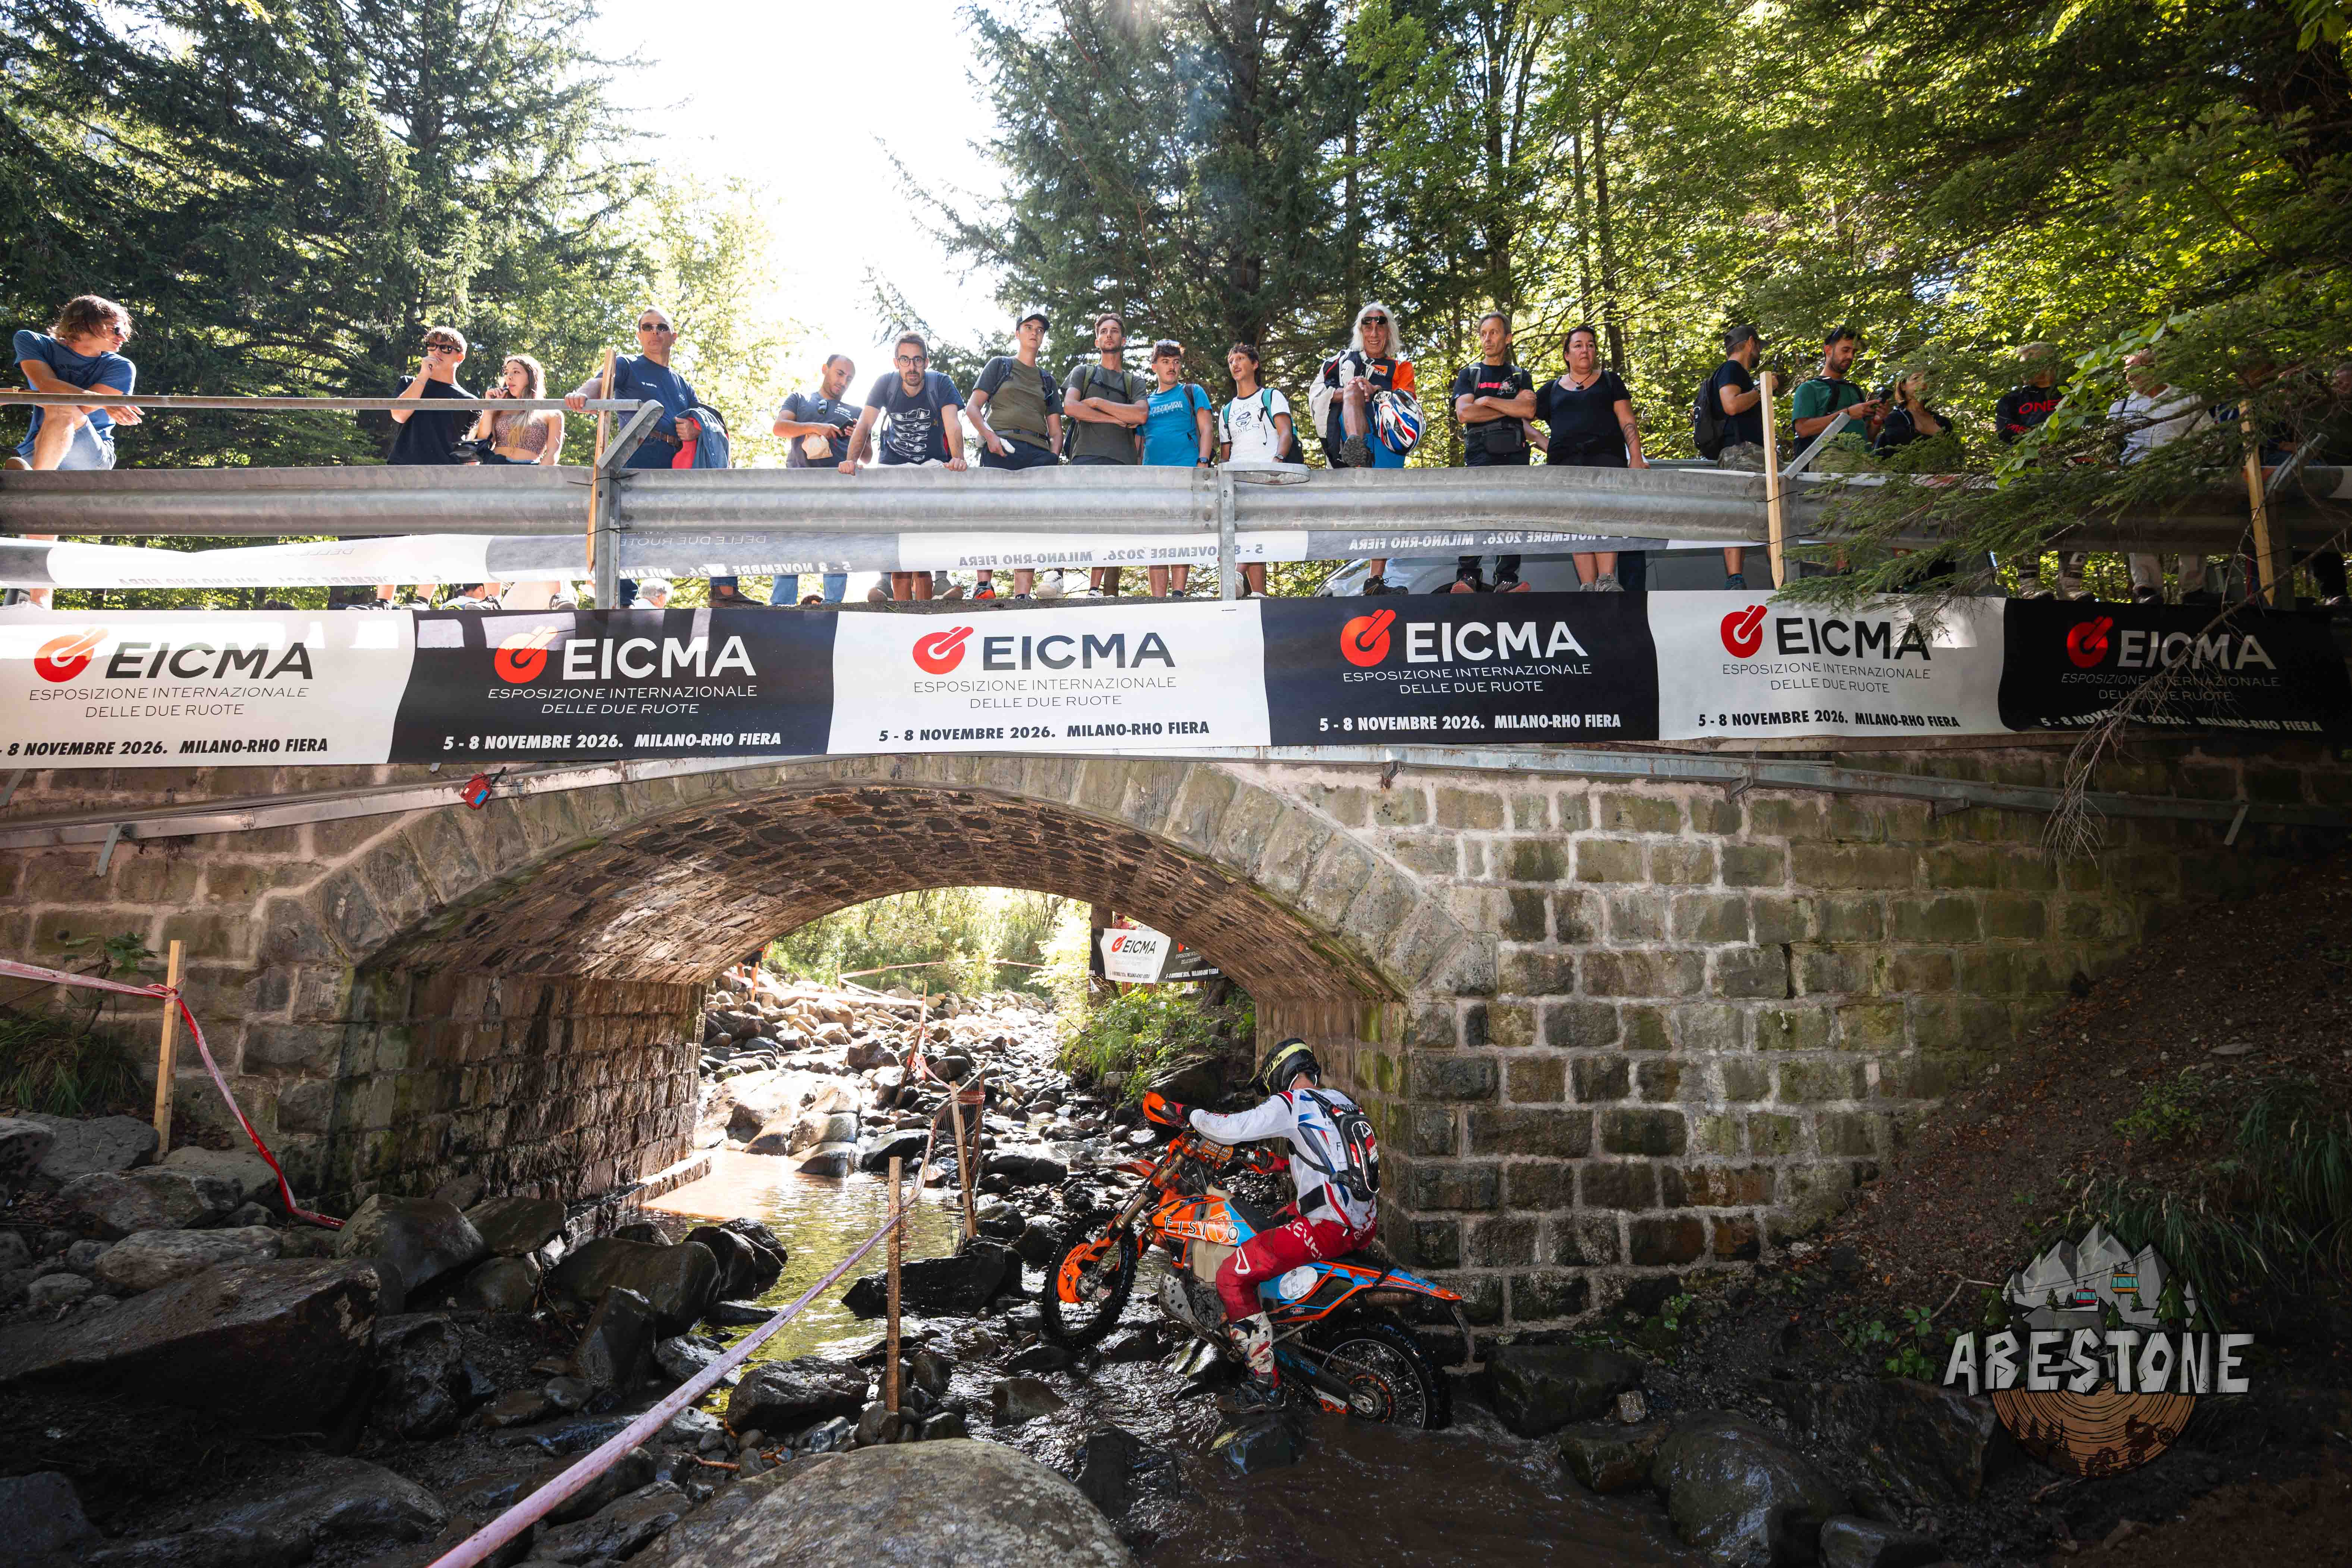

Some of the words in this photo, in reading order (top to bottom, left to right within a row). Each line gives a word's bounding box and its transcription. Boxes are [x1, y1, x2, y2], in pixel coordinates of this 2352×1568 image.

[1406, 621, 1588, 663] EICMA
[1776, 617, 1932, 660] EICMA
[563, 635, 757, 680] EICMA
[983, 632, 1176, 671] EICMA
[2117, 630, 2277, 670] EICMA
[105, 642, 313, 680] EICMA
[1343, 669, 1453, 682] ESPOSIZIONE
[1456, 664, 1592, 678] INTERNAZIONALE
[1723, 662, 1821, 675] ESPOSIZIONE
[1823, 663, 1931, 679] INTERNAZIONALE
[488, 688, 606, 699] ESPOSIZIONE
[610, 685, 757, 698] INTERNAZIONALE
[914, 680, 1029, 693] ESPOSIZIONE
[1033, 677, 1177, 690] INTERNAZIONALE
[1400, 683, 1451, 694] DELLE
[1454, 682, 1487, 692] DUE
[1491, 681, 1544, 692] RUOTE
[1771, 678, 1820, 690] DELLE
[1822, 678, 1847, 690] DUE
[1849, 681, 1890, 693] RUOTE
[29, 688, 150, 701] ESPOSIZIONE
[153, 687, 309, 698] INTERNAZIONALE
[970, 698, 1023, 708] DELLE
[1027, 697, 1062, 707] DUE
[1066, 695, 1122, 706] RUOTE
[85, 706, 141, 717] DELLE
[145, 705, 181, 716] DUE
[185, 704, 244, 716] RUOTE
[541, 704, 597, 714] DELLE
[601, 704, 637, 714] DUE
[641, 704, 700, 714] RUOTE
[1320, 718, 1329, 731] 5
[1343, 717, 1353, 731] 8
[1358, 716, 1437, 730] NOVEMBRE
[1442, 715, 1485, 729] 2026.
[1494, 714, 1580, 728] MILANO-RHO
[1585, 714, 1621, 728] FIERA
[1698, 714, 1706, 727] 5
[1719, 714, 1727, 726] 8
[1732, 710, 1809, 726] NOVEMBRE
[1814, 710, 1848, 723] 2026.
[1855, 712, 1925, 726] MILANO-RHO
[1927, 716, 1960, 727] FIERA
[2040, 717, 2051, 726] 5
[2059, 716, 2072, 726] 8
[2196, 717, 2280, 730] MILANO-RHO
[2283, 720, 2323, 732] FIERA
[879, 730, 888, 742] 5
[904, 729, 914, 741] 8
[920, 728, 1004, 741] NOVEMBRE
[1010, 726, 1055, 739] 2026.
[1067, 722, 1162, 737] MILANO-RHO
[1168, 721, 1209, 734] FIERA
[7, 743, 20, 756] 8
[23, 742, 116, 756] NOVEMBRE
[119, 741, 167, 754] 2026.
[179, 739, 280, 754] MILANO-RHO
[285, 738, 327, 752] FIERA
[443, 736, 454, 750] 5
[469, 736, 480, 750] 8
[484, 735, 572, 749] NOVEMBRE
[576, 734, 623, 748] 2026.
[634, 733, 734, 747] MILANO-RHO
[738, 732, 781, 745] FIERA
[1122, 940, 1156, 954] EICMA
